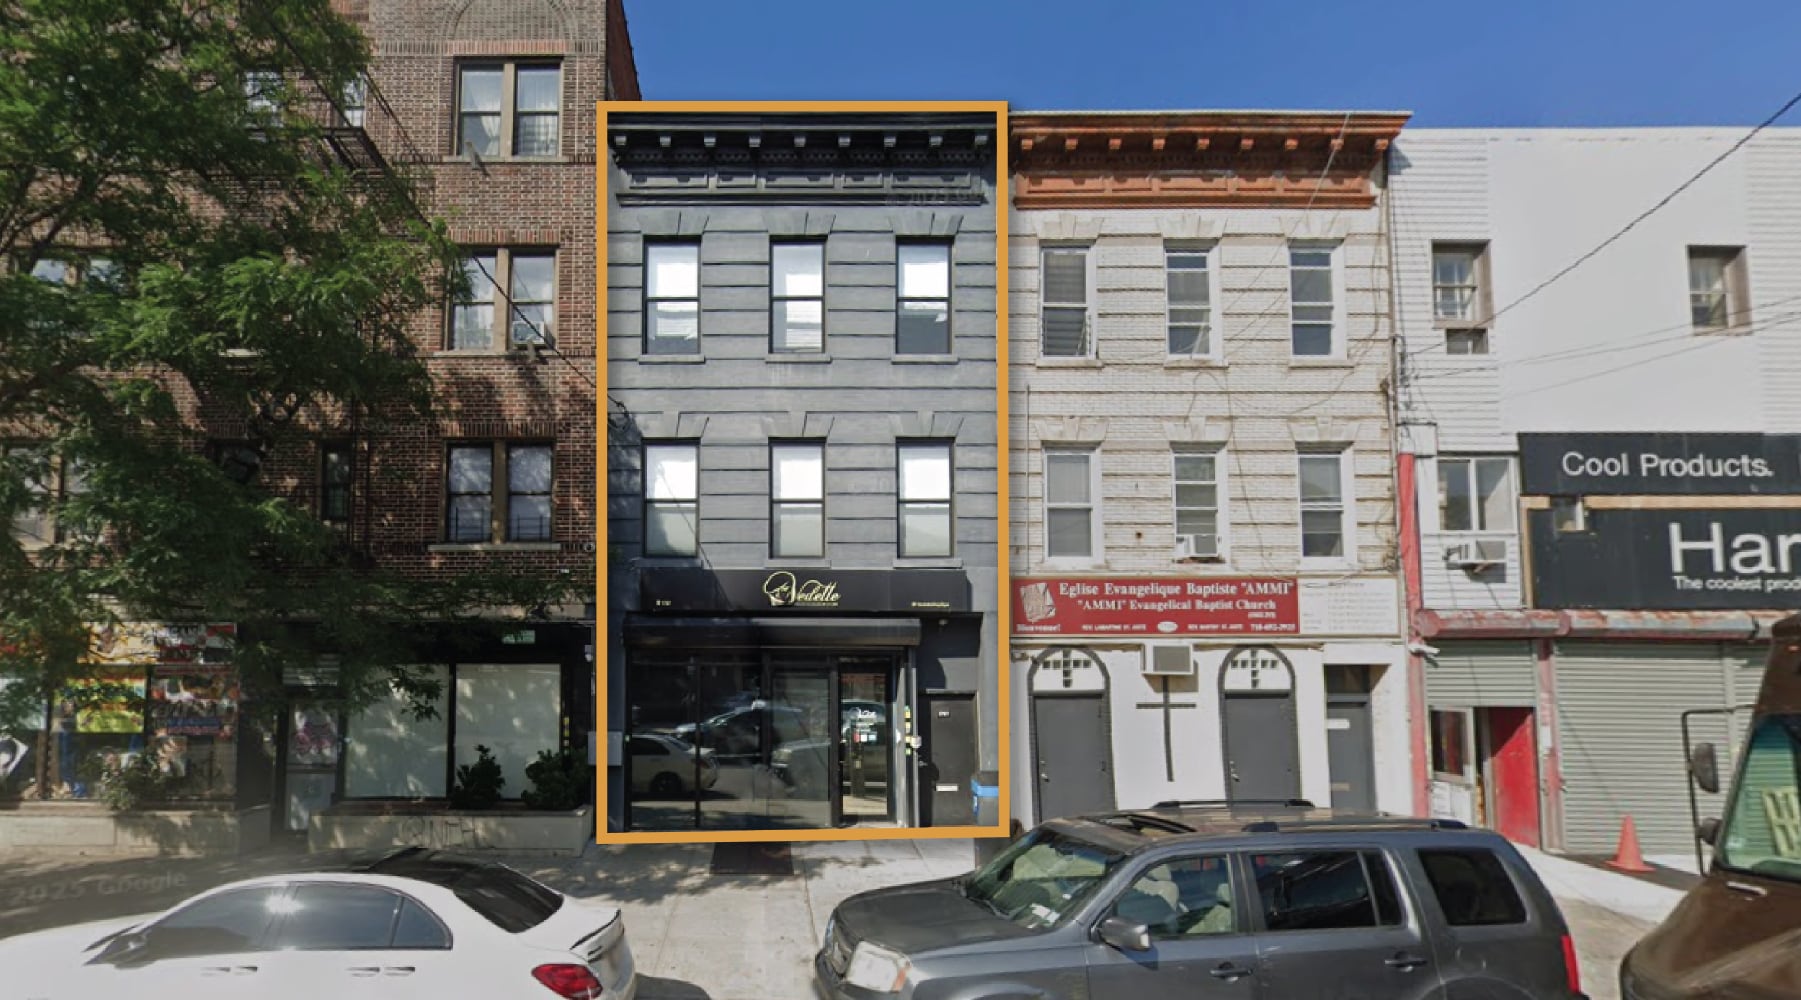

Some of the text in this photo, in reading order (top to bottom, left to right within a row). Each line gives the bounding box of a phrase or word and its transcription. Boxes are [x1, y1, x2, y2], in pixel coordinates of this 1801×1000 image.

[1562, 451, 1774, 477] Cool Products.
[1059, 582, 1098, 598] Eglise
[1103, 582, 1180, 598] Evangelique
[1186, 582, 1237, 598] Baptiste
[1672, 575, 1703, 590] The
[1705, 576, 1762, 590] coolest
[1130, 600, 1191, 612] Evangelical
[1195, 600, 1233, 612] Baptist
[1236, 600, 1276, 610] Church
